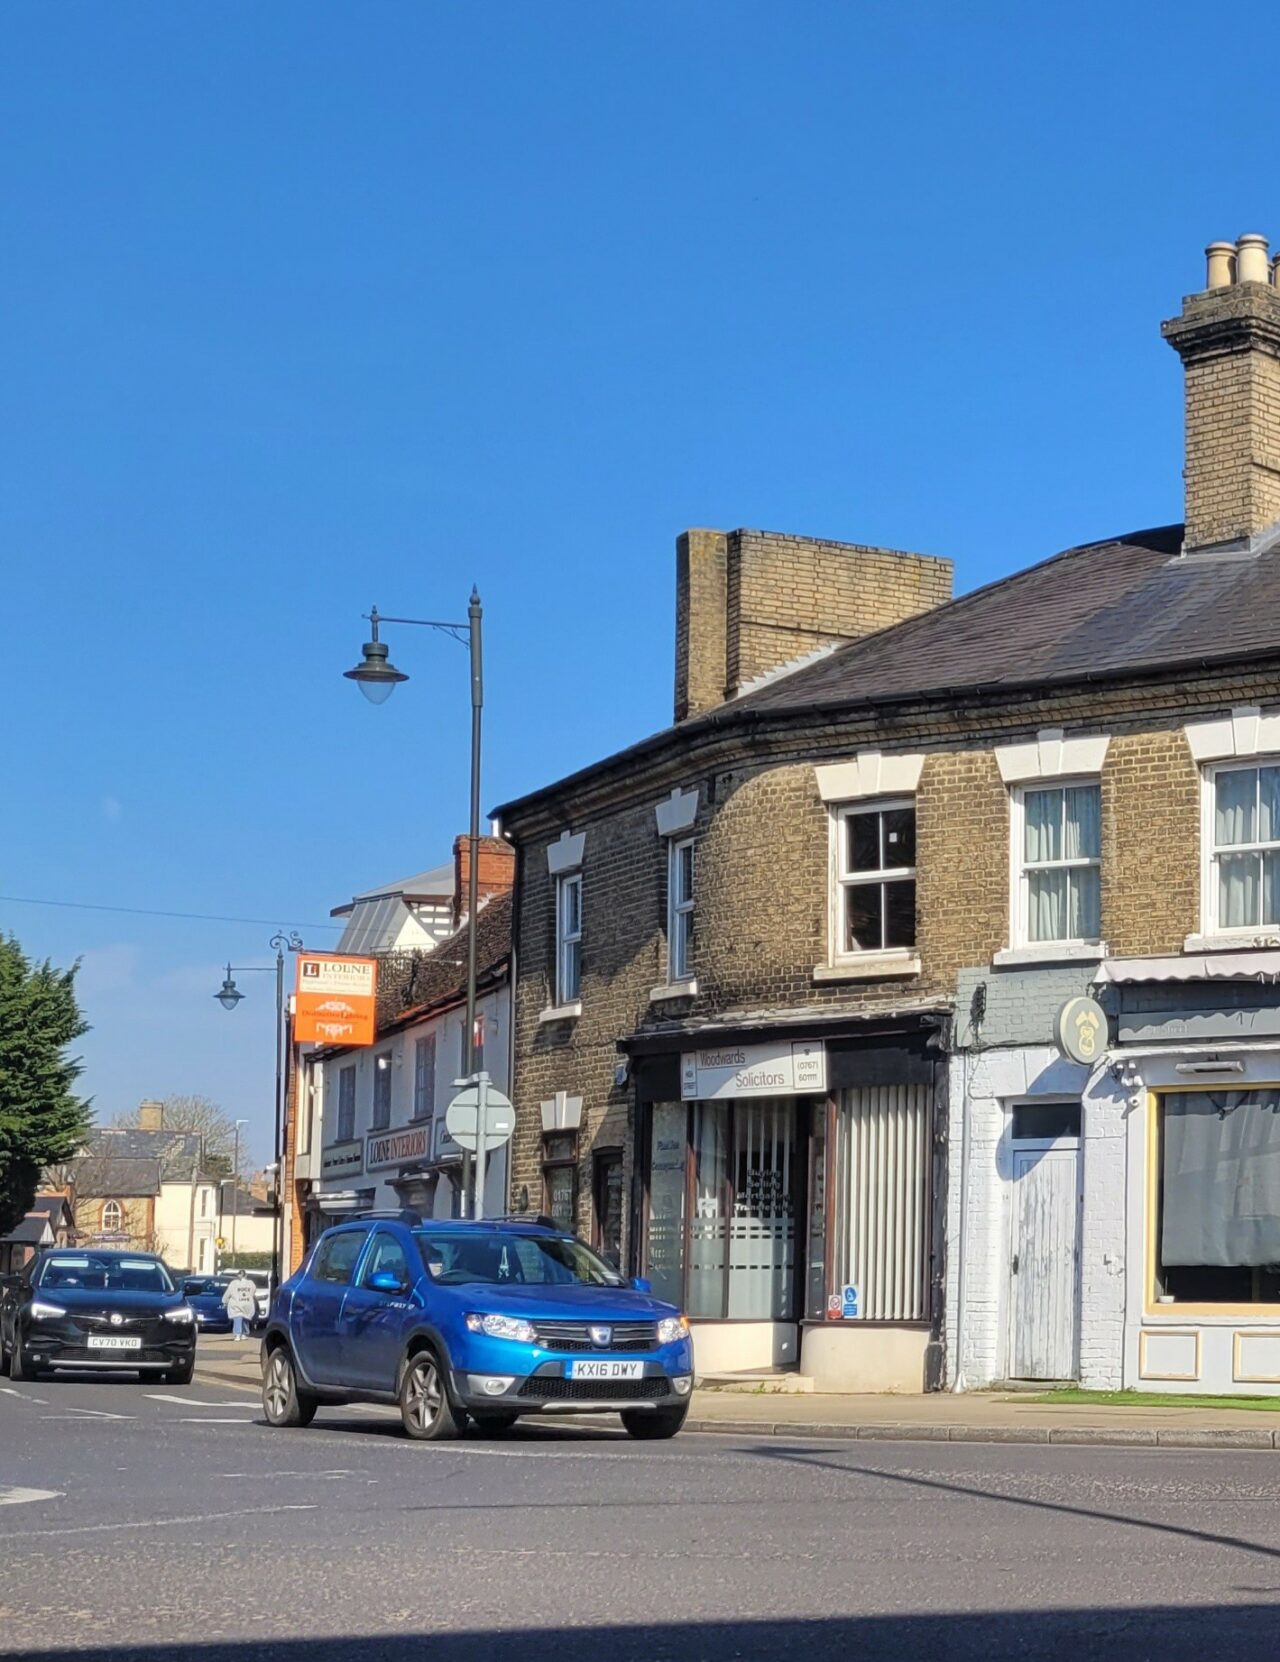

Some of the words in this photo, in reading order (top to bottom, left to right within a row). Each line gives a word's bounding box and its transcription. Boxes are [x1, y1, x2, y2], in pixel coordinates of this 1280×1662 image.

[700, 1050, 746, 1066] Woodwards
[735, 1071, 785, 1088] Solicitors
[577, 1363, 608, 1376] KX16
[611, 1363, 637, 1376] DWY
